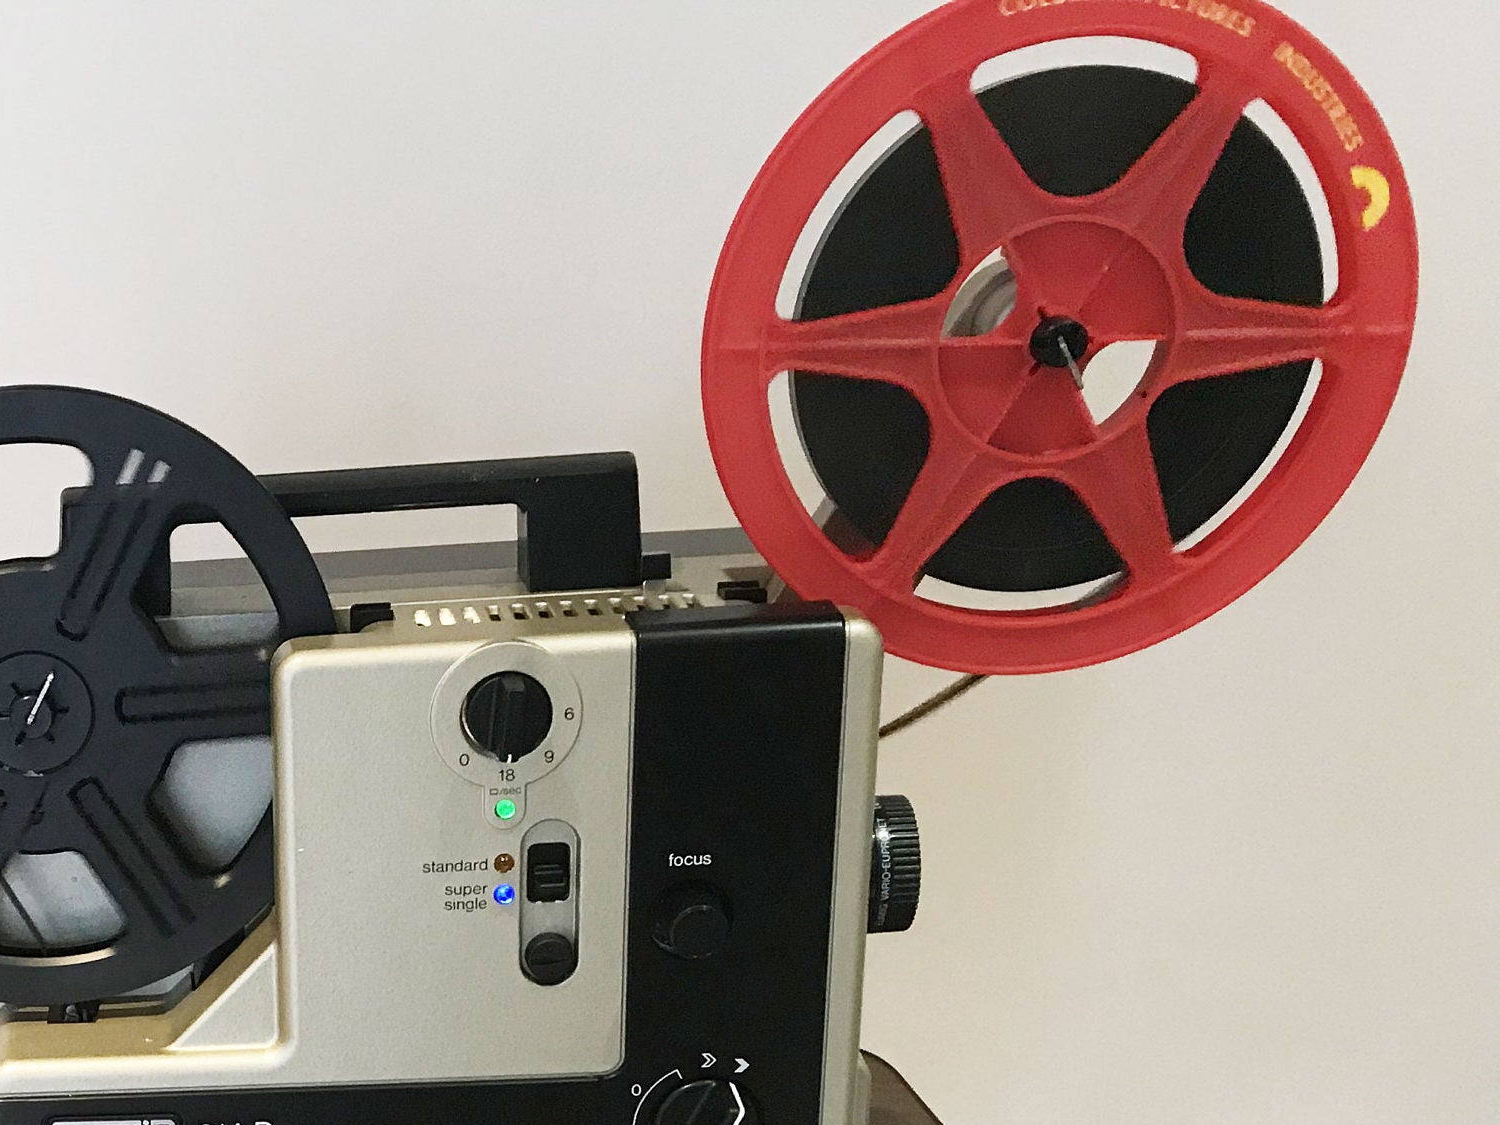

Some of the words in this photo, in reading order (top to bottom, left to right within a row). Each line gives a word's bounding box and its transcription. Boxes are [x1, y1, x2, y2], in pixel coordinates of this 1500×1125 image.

[564, 707, 575, 720] 6
[459, 753, 470, 767] 0
[544, 750, 555, 763] 9
[499, 769, 516, 782] 18
[422, 859, 489, 873] standard
[668, 853, 712, 867] focus
[444, 884, 488, 898] super
[444, 897, 488, 913] single
